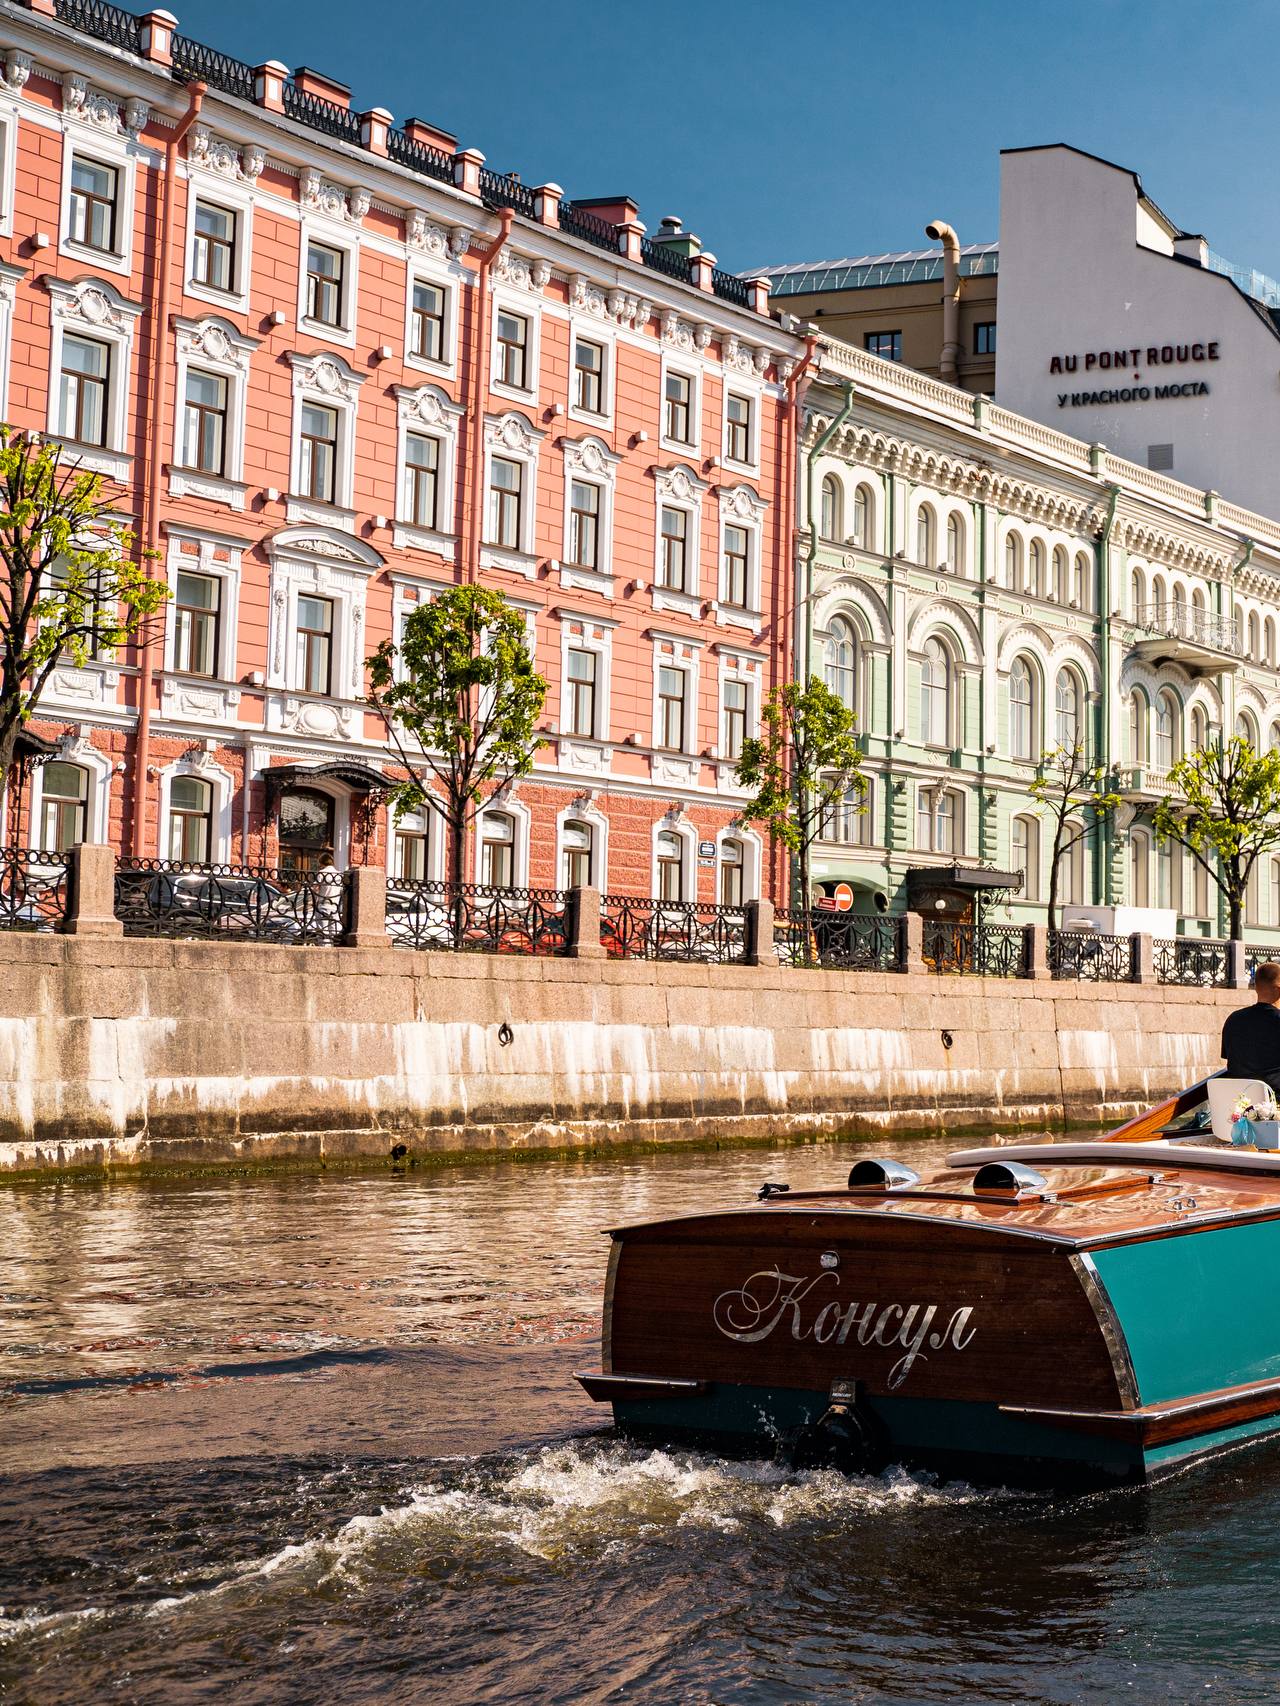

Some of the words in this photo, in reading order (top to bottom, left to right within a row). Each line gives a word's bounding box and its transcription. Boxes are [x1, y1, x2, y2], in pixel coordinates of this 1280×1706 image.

[1050, 355, 1077, 374] AU
[1085, 349, 1140, 371] PONT
[1147, 342, 1219, 366] ROUGE
[1057, 394, 1068, 408] У
[1071, 387, 1150, 408] КРАСНОГО
[1155, 382, 1209, 400] МОСТА
[713, 1264, 976, 1389] Консул
